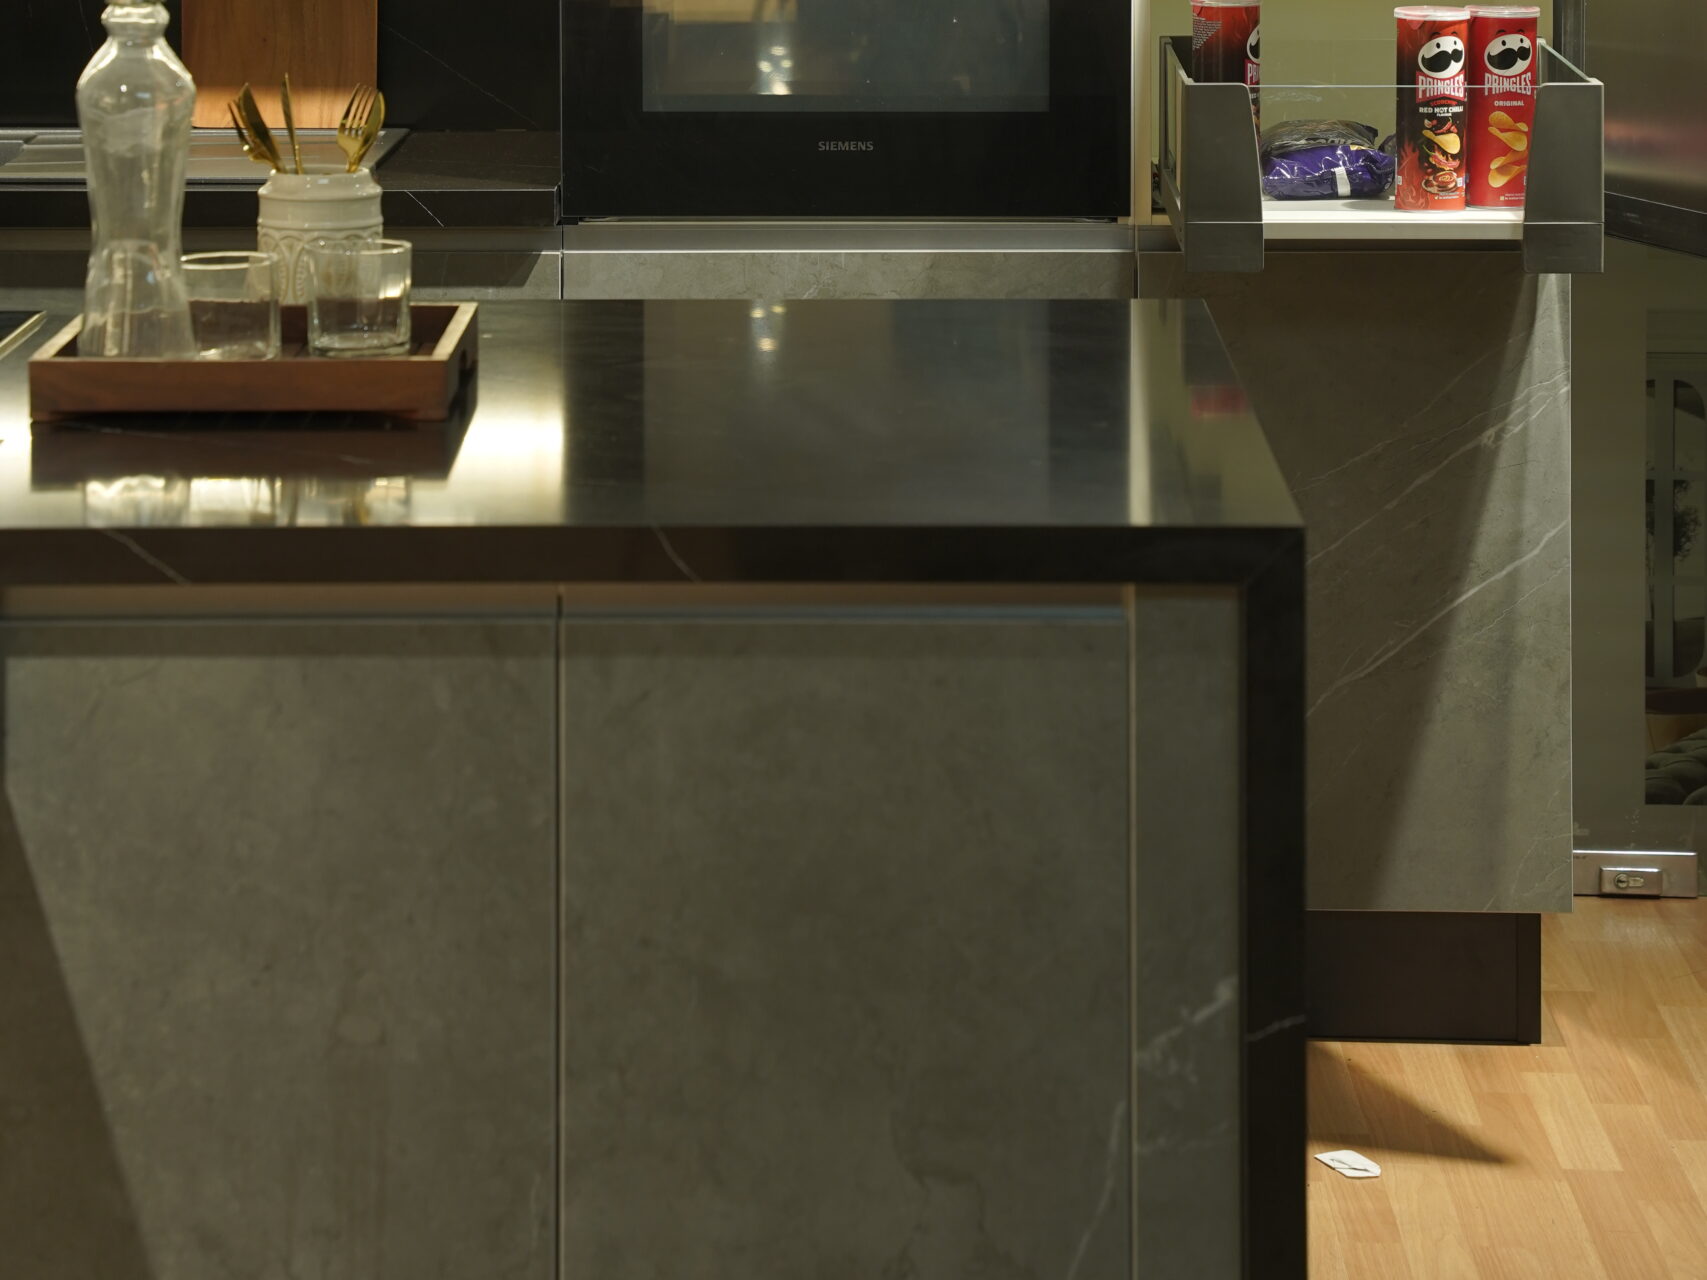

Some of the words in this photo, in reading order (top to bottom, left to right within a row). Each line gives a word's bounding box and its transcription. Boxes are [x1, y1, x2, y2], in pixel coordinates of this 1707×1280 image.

[1418, 73, 1464, 98] PRINGLES
[1485, 72, 1531, 96] PRINGLES
[817, 141, 874, 151] SIEMENS
